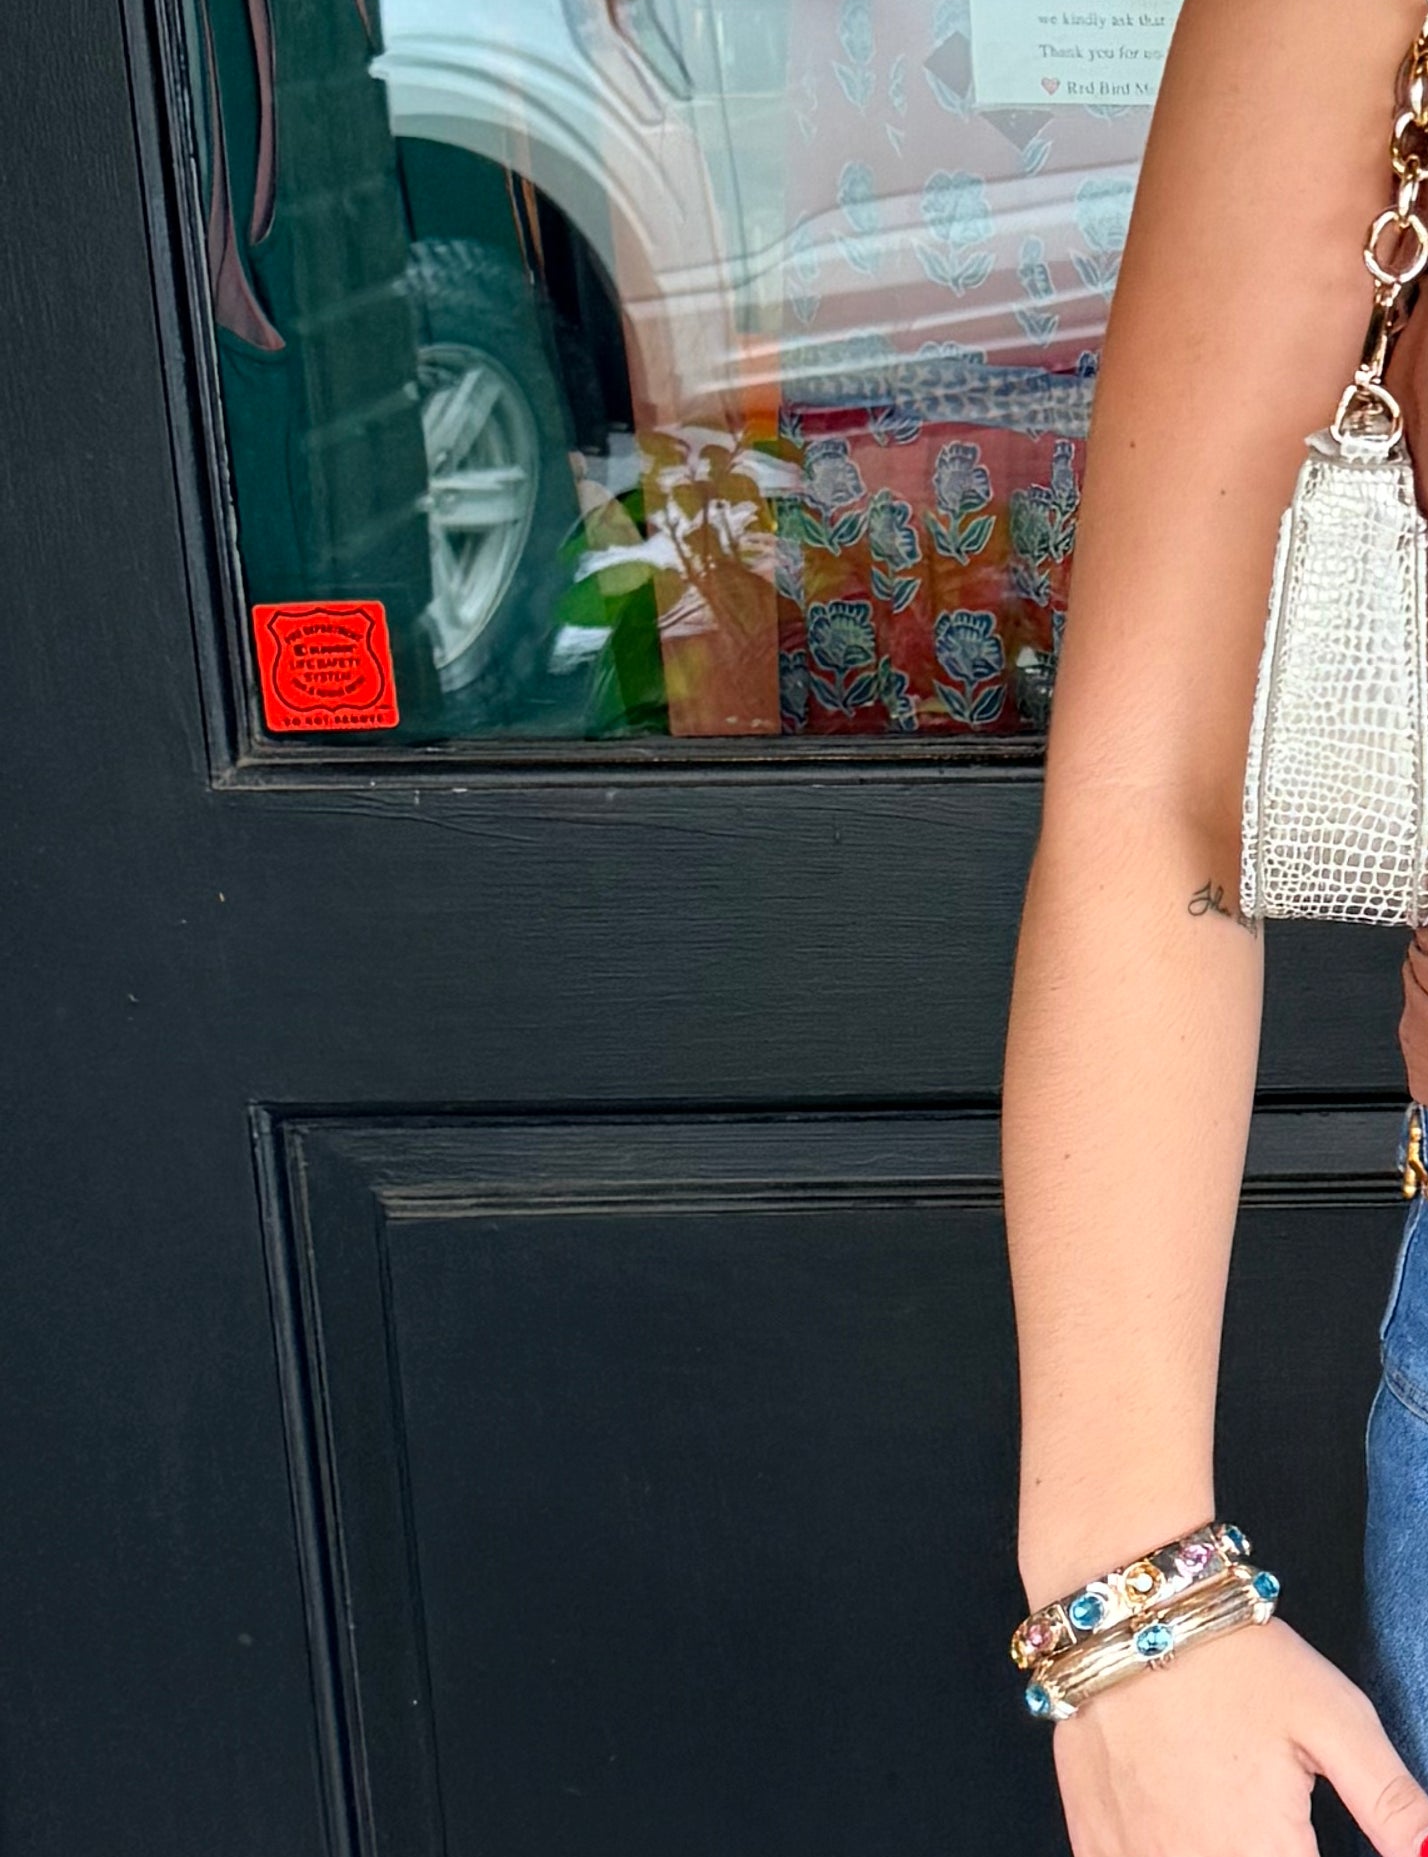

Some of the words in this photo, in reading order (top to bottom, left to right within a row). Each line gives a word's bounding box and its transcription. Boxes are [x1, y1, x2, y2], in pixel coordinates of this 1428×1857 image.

[1038, 16, 1058, 26] we
[1062, 12, 1106, 30] kindly
[1111, 13, 1134, 26] ask
[1138, 14, 1165, 27] that
[1038, 43, 1084, 59] Thank
[1087, 49, 1115, 62] you
[1118, 45, 1139, 60] for
[1066, 81, 1095, 96] Red
[1099, 81, 1130, 96] Bird
